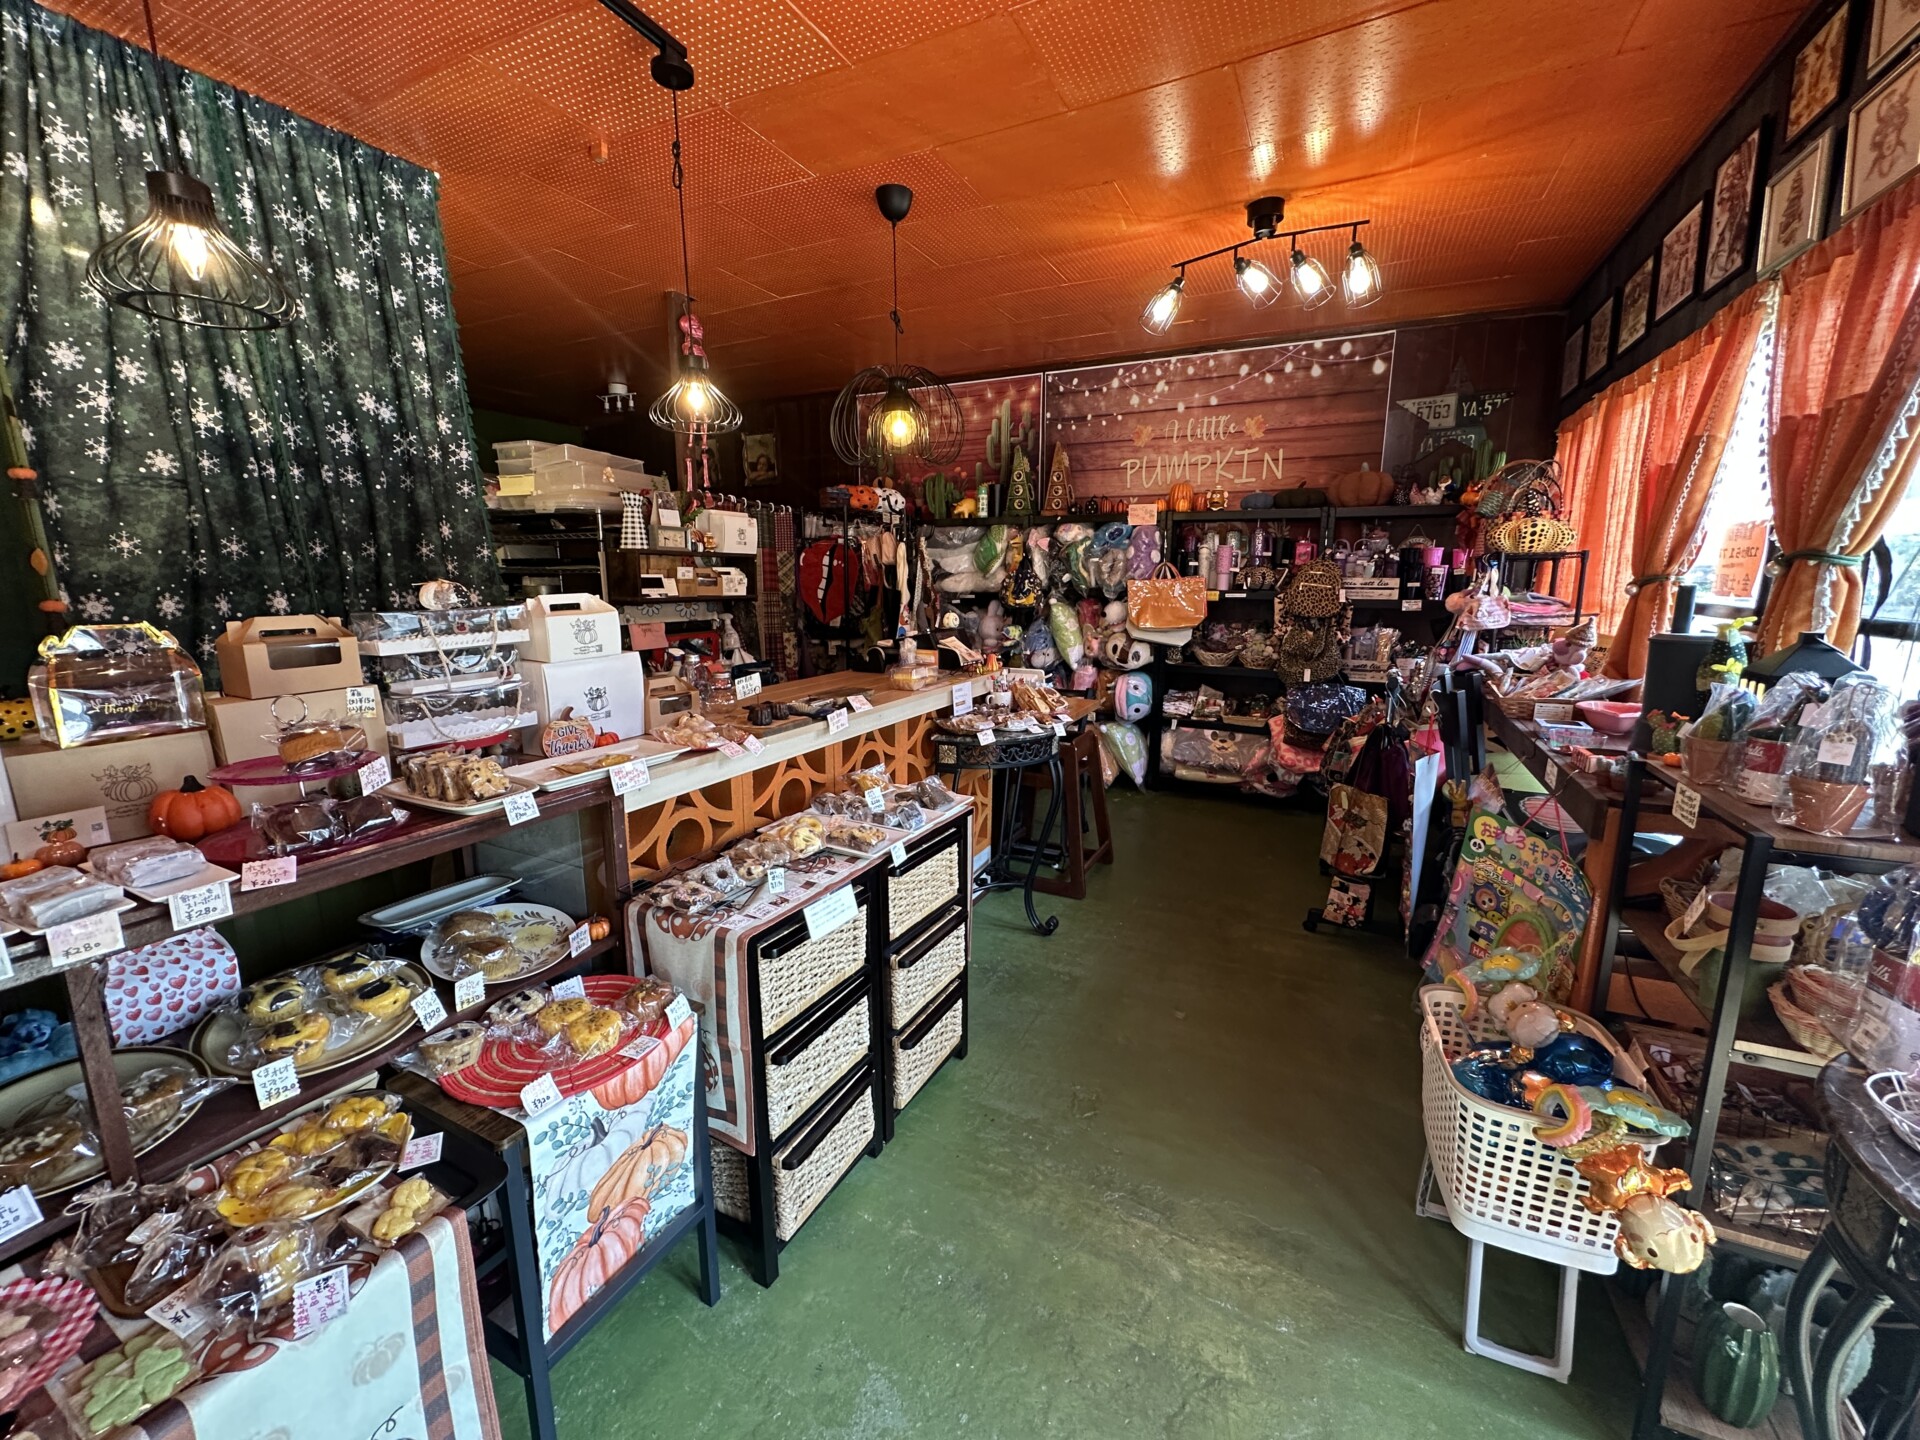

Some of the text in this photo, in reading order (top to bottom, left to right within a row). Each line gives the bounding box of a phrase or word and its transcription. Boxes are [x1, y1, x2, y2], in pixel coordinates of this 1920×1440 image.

[1411, 399, 1438, 407] TEXAS
[1480, 392, 1507, 400] TEXAS
[1164, 414, 1239, 444] A little
[1120, 447, 1284, 489] PUMPKIN
[557, 725, 579, 738] GIVE
[550, 737, 592, 756] thanks
[1528, 841, 1560, 867] キャラ
[250, 878, 281, 888] ¥260
[184, 906, 218, 922] ¥280
[62, 942, 102, 959] ¥280
[264, 1082, 297, 1102] ¥320
